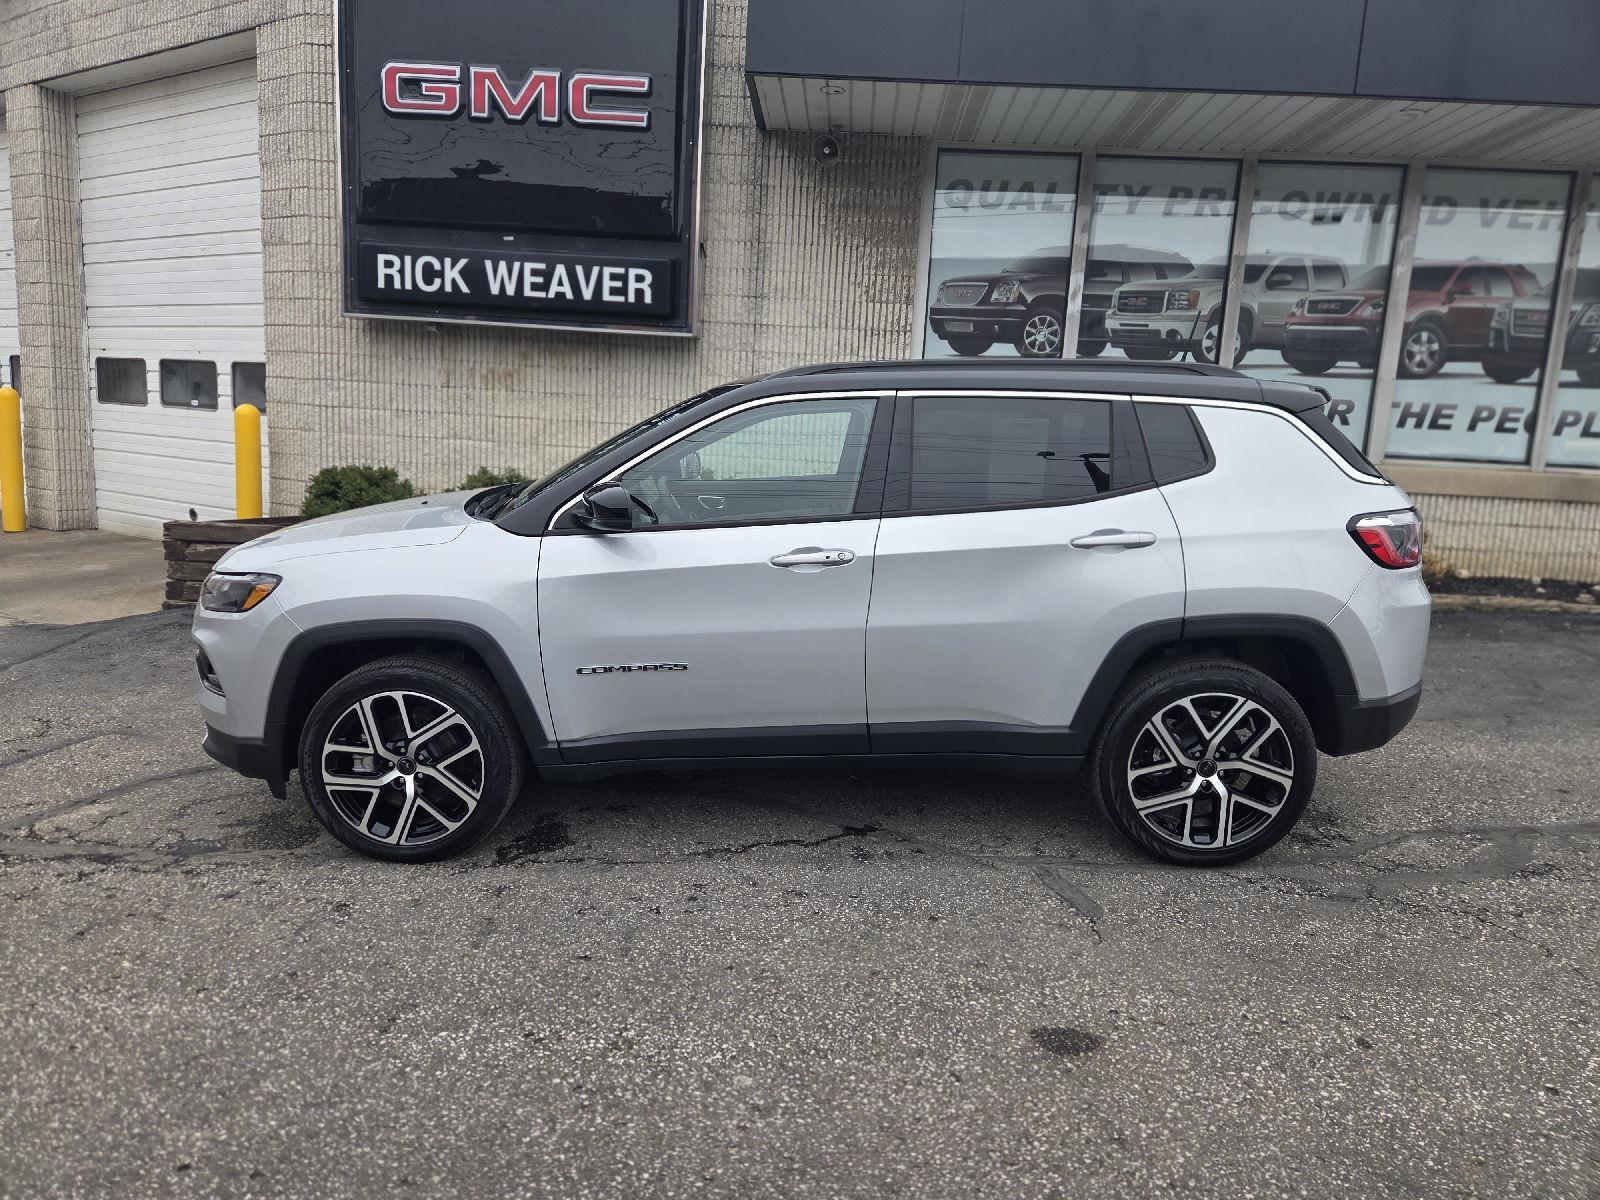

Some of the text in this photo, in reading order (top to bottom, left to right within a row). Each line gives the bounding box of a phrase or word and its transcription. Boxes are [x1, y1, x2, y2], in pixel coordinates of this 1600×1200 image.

[381, 62, 650, 127] GMC
[944, 178, 1152, 215] QUALTY
[1163, 186, 1458, 225] PR-OWND
[377, 253, 653, 304] RICK WEAVER
[1391, 401, 1458, 431] HE
[576, 661, 689, 675] COMPASS
